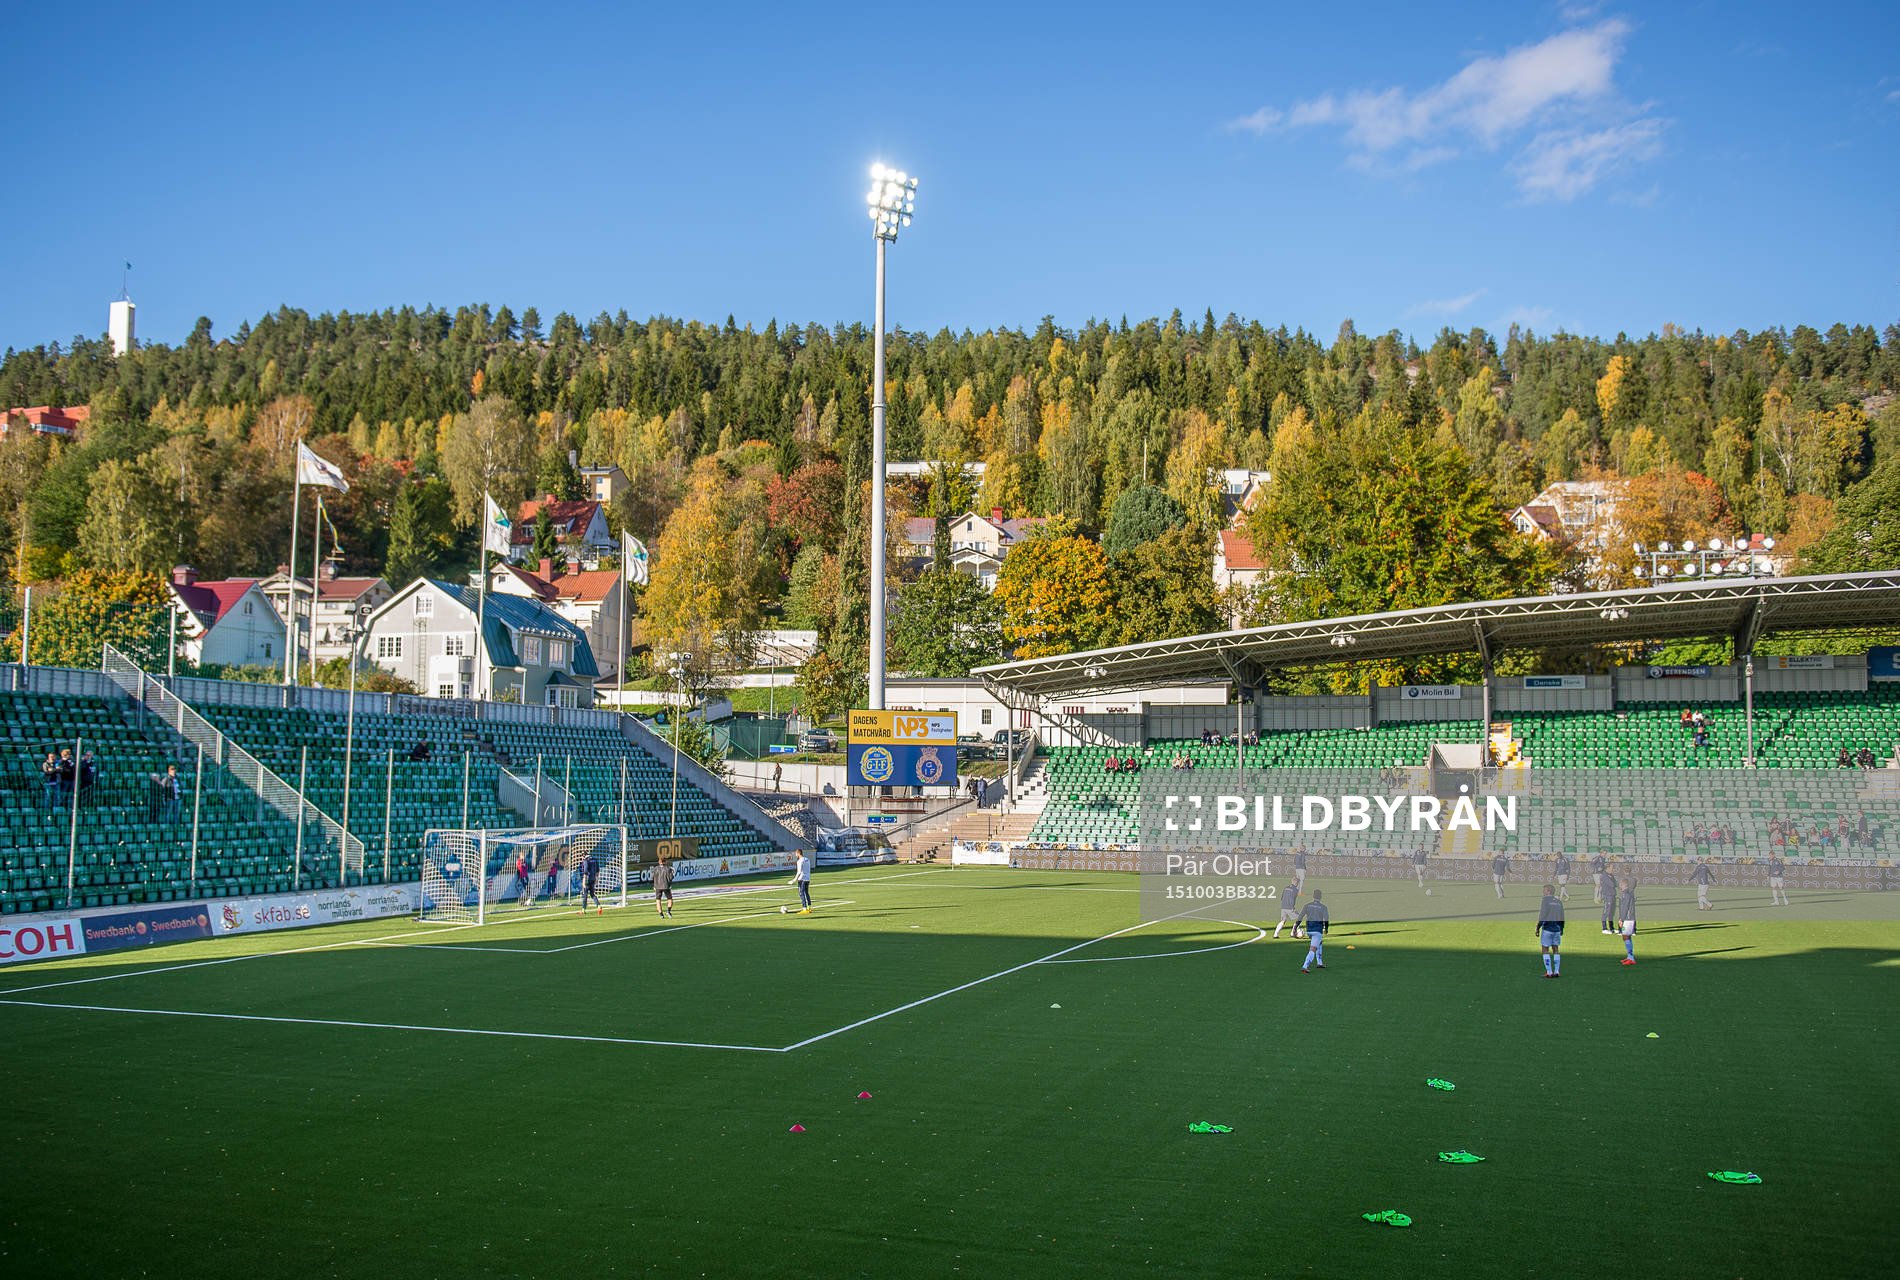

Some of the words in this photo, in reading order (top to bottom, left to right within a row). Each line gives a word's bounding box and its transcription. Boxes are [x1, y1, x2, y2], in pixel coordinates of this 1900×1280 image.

[853, 715, 878, 725] DAGENS
[896, 717, 929, 737] NP3
[853, 727, 891, 738] MATCHVÄRD
[254, 906, 310, 924] skfab.se
[86, 924, 136, 940] Swedbank
[151, 917, 197, 932] Swedbank
